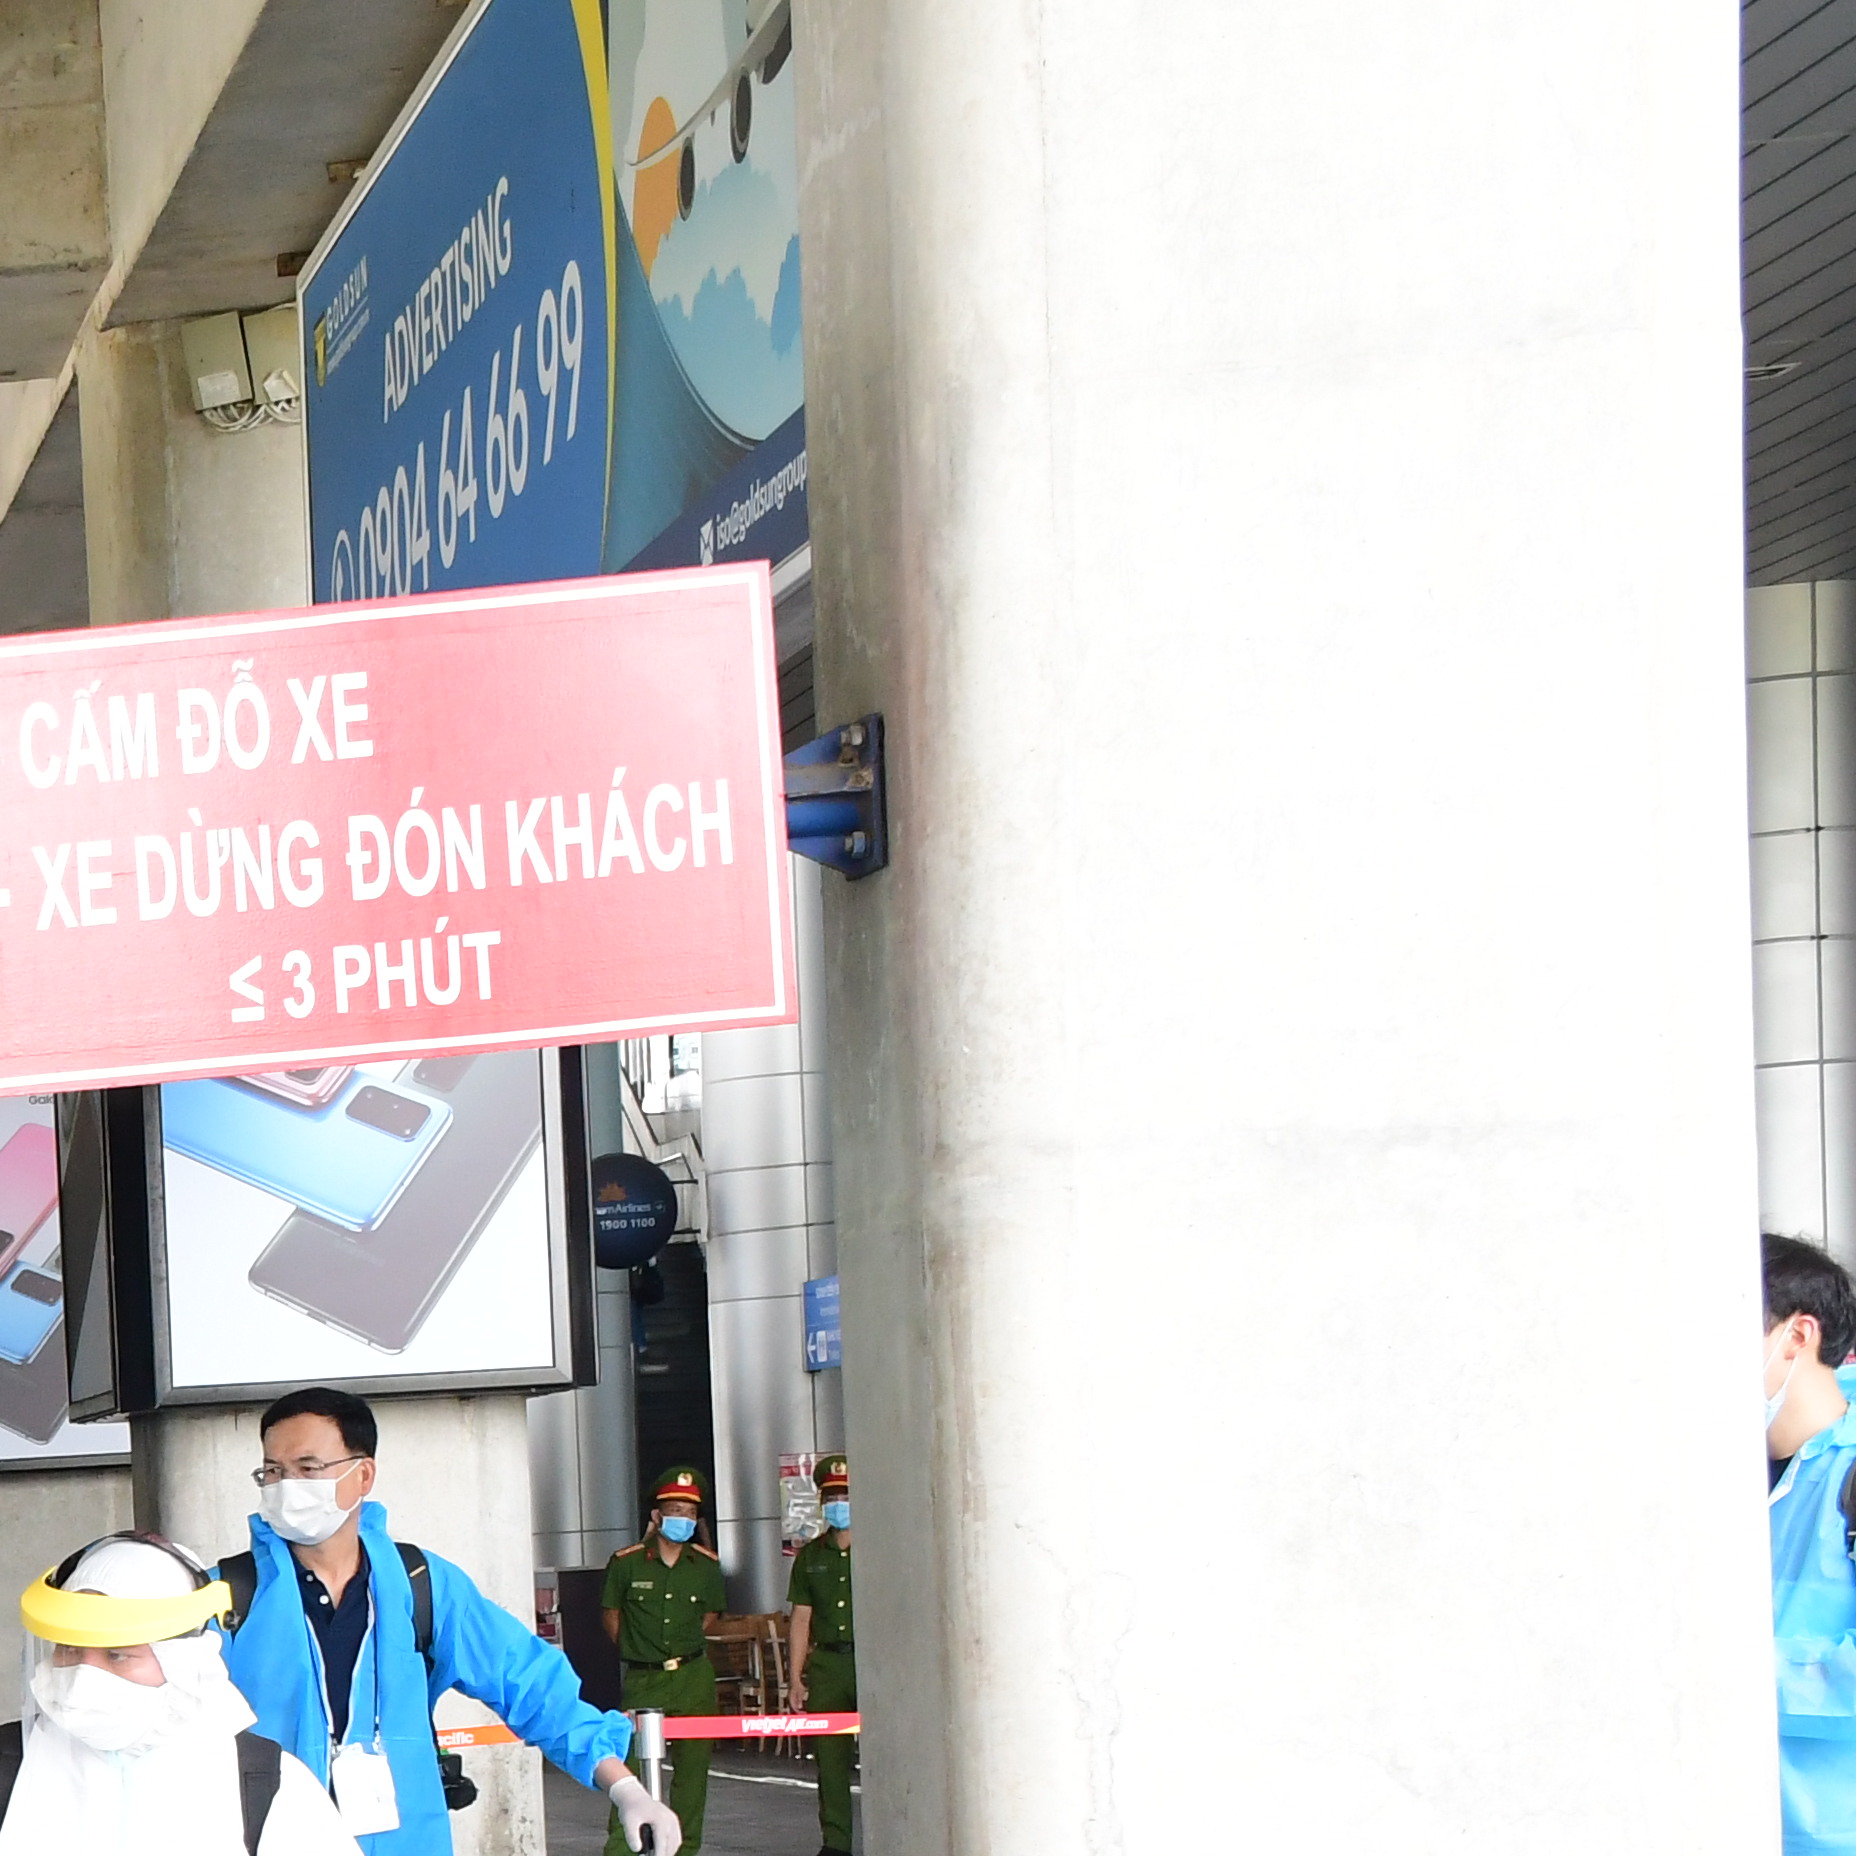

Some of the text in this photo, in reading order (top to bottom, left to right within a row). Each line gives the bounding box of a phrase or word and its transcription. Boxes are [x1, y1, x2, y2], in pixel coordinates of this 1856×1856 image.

[327, 255, 367, 340] GOLDSUN
[384, 175, 512, 424] ADVERTISING
[359, 260, 583, 602] 0904 64 66 99
[18, 659, 374, 789] CẤM ĐỖ XE
[32, 766, 734, 931] XE DỪNG ĐÓN KHÁCH
[282, 949, 316, 1020] 3
[333, 916, 501, 1016] PHÚT
[600, 1217, 656, 1230] 1900 1100
